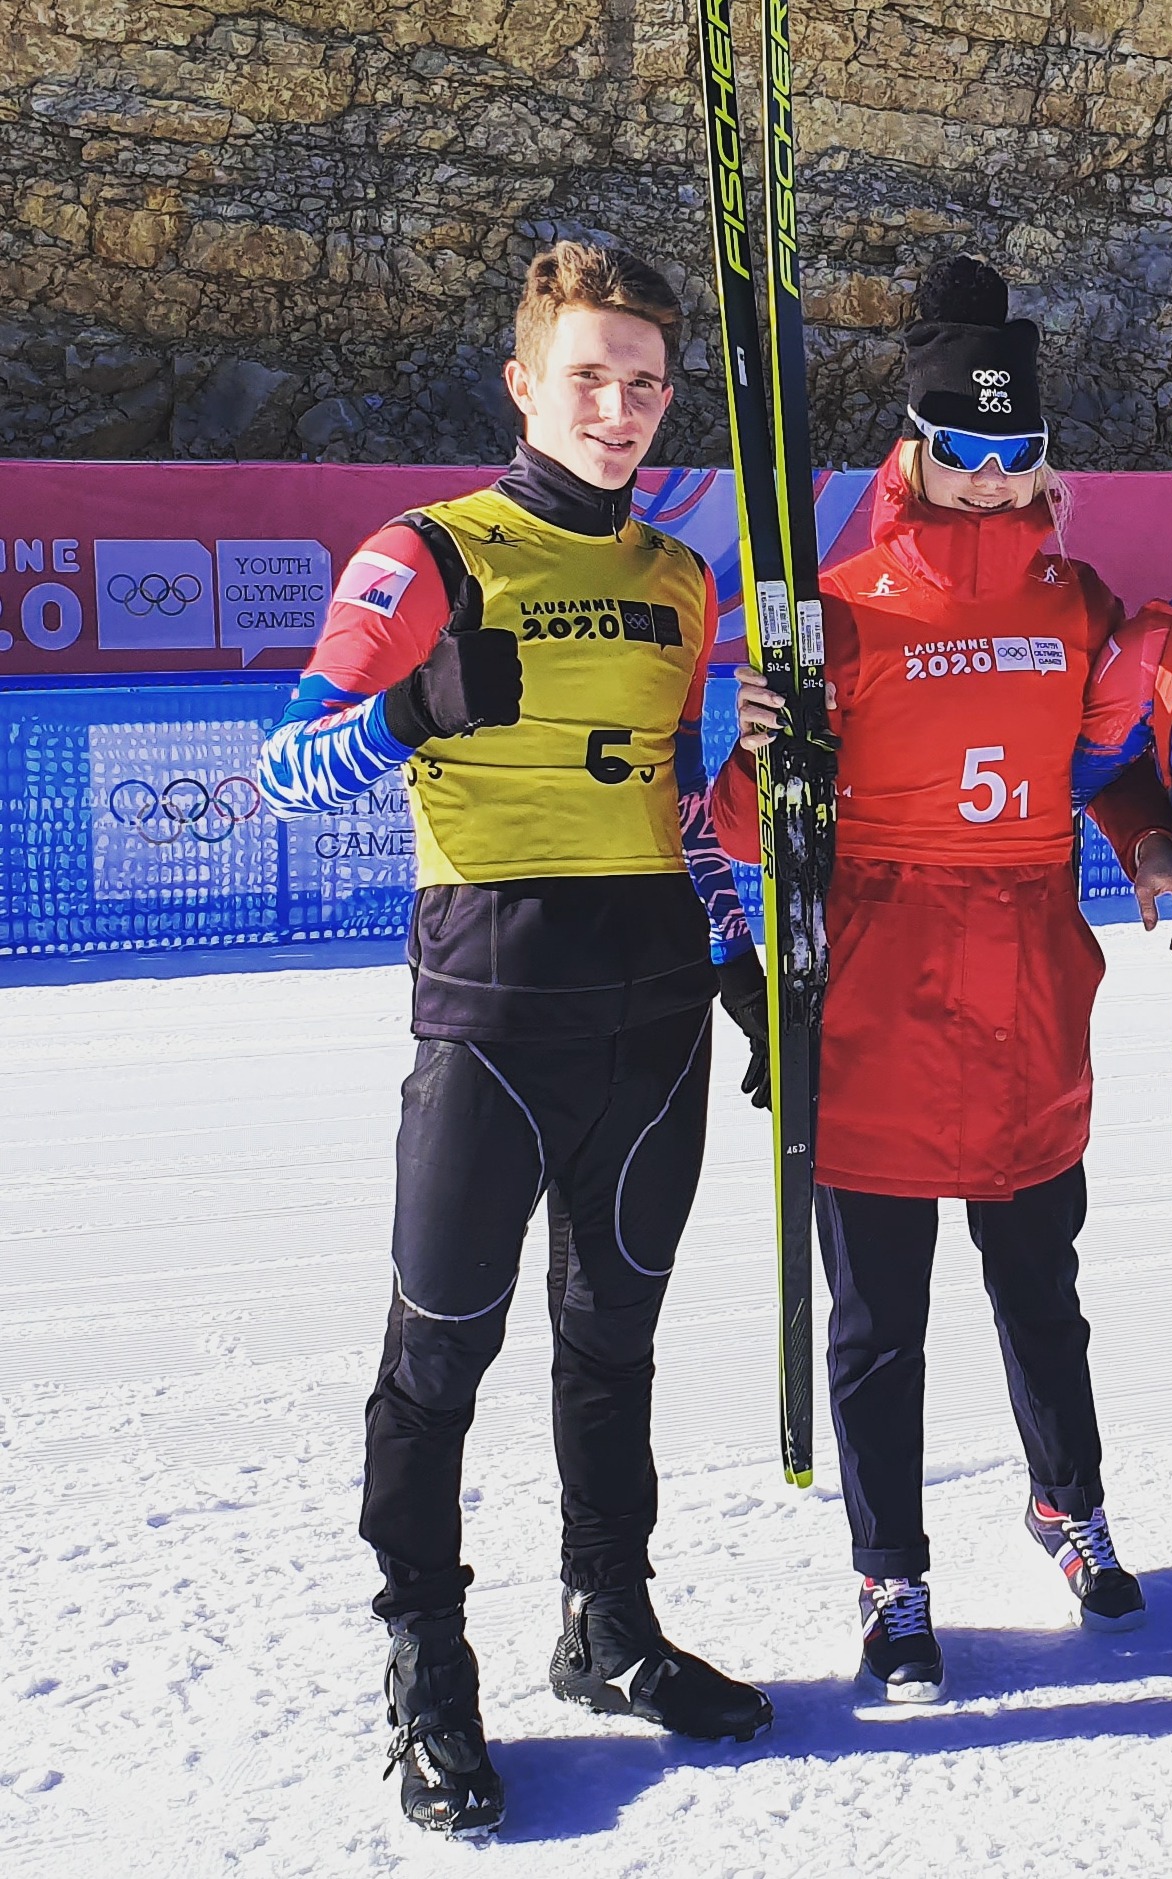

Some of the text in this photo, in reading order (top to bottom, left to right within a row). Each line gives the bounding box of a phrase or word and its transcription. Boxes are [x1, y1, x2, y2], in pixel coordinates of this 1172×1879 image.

[707, 0, 750, 281] FISCHER
[769, 0, 799, 299] FISCHER
[978, 397, 1012, 413] 365
[235, 557, 312, 575] YOUTH
[225, 584, 324, 602] OLYMPIC
[520, 599, 617, 616] LAUSANNE
[236, 611, 316, 629] GAMES
[522, 613, 620, 641] 2020
[904, 638, 989, 657] LAUSANNE
[905, 651, 992, 681] 2020
[958, 745, 1007, 823] 5
[315, 829, 416, 859] GAME
